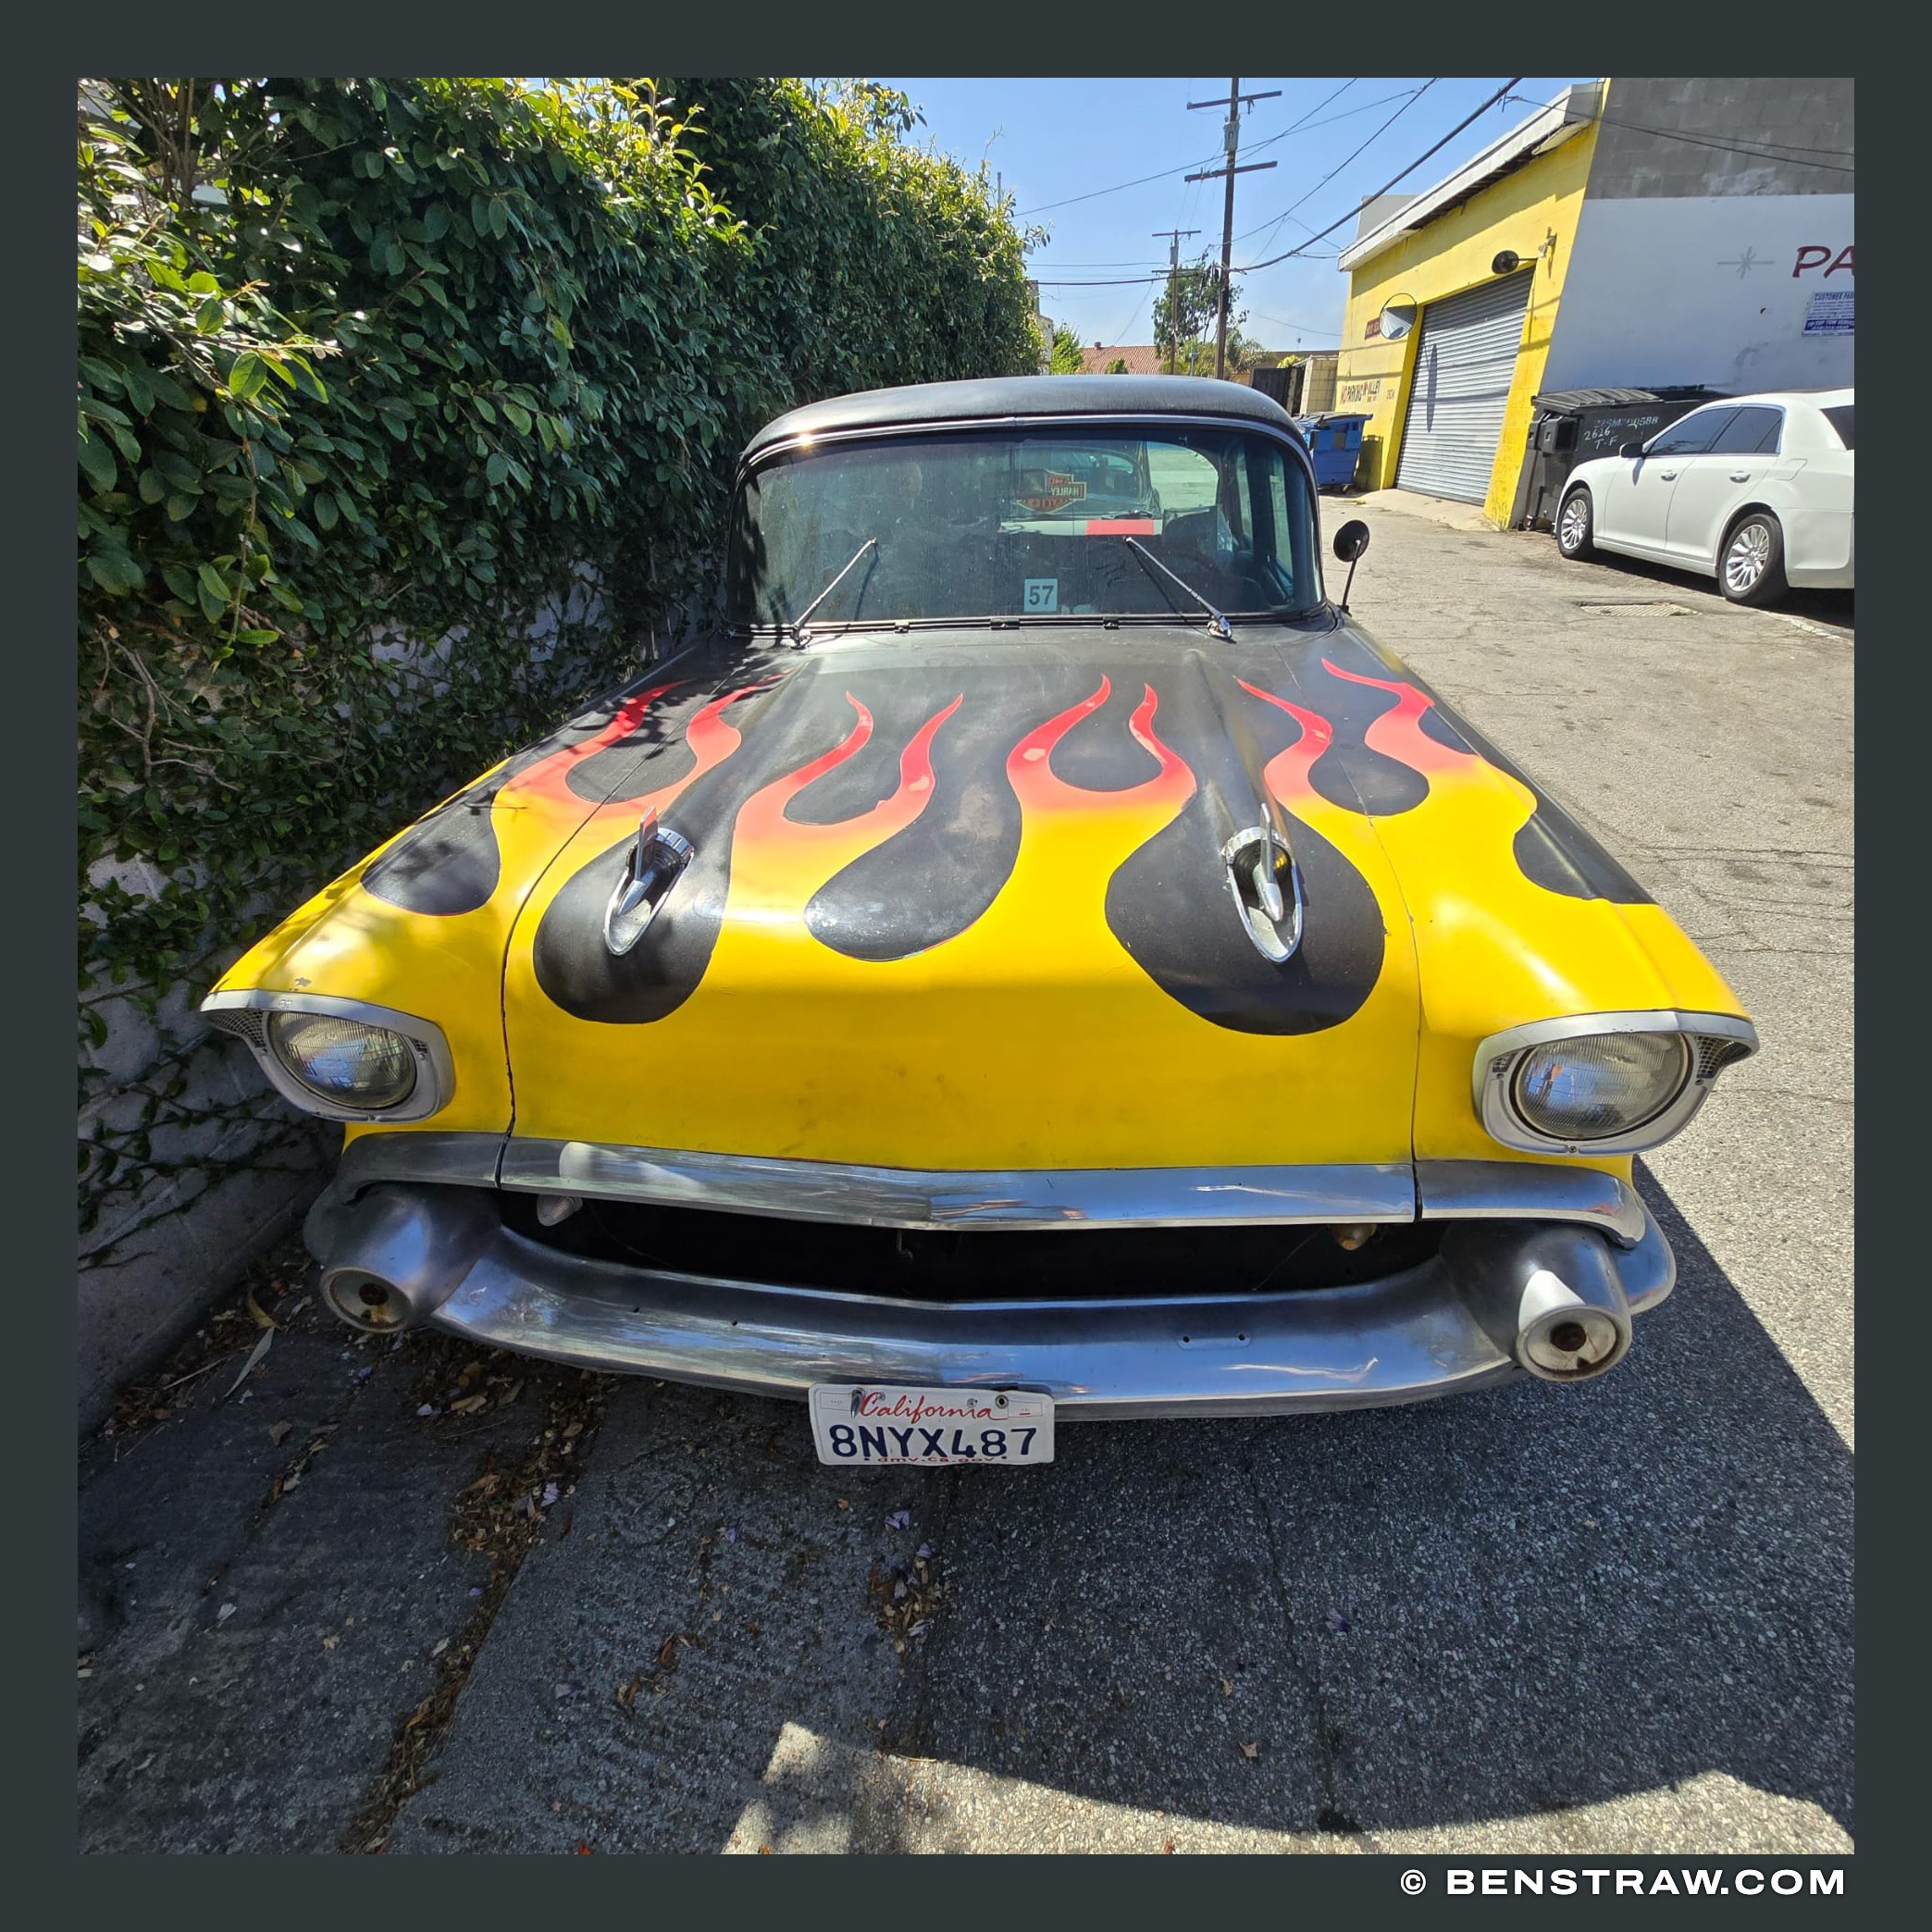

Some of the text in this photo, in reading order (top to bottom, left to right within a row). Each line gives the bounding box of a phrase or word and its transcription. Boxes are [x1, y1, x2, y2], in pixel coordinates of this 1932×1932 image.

[1584, 426, 1611, 440] 2626
[1029, 585, 1055, 606] 57
[860, 1392, 1009, 1424] California
[829, 1424, 1037, 1457] 8NYX487
